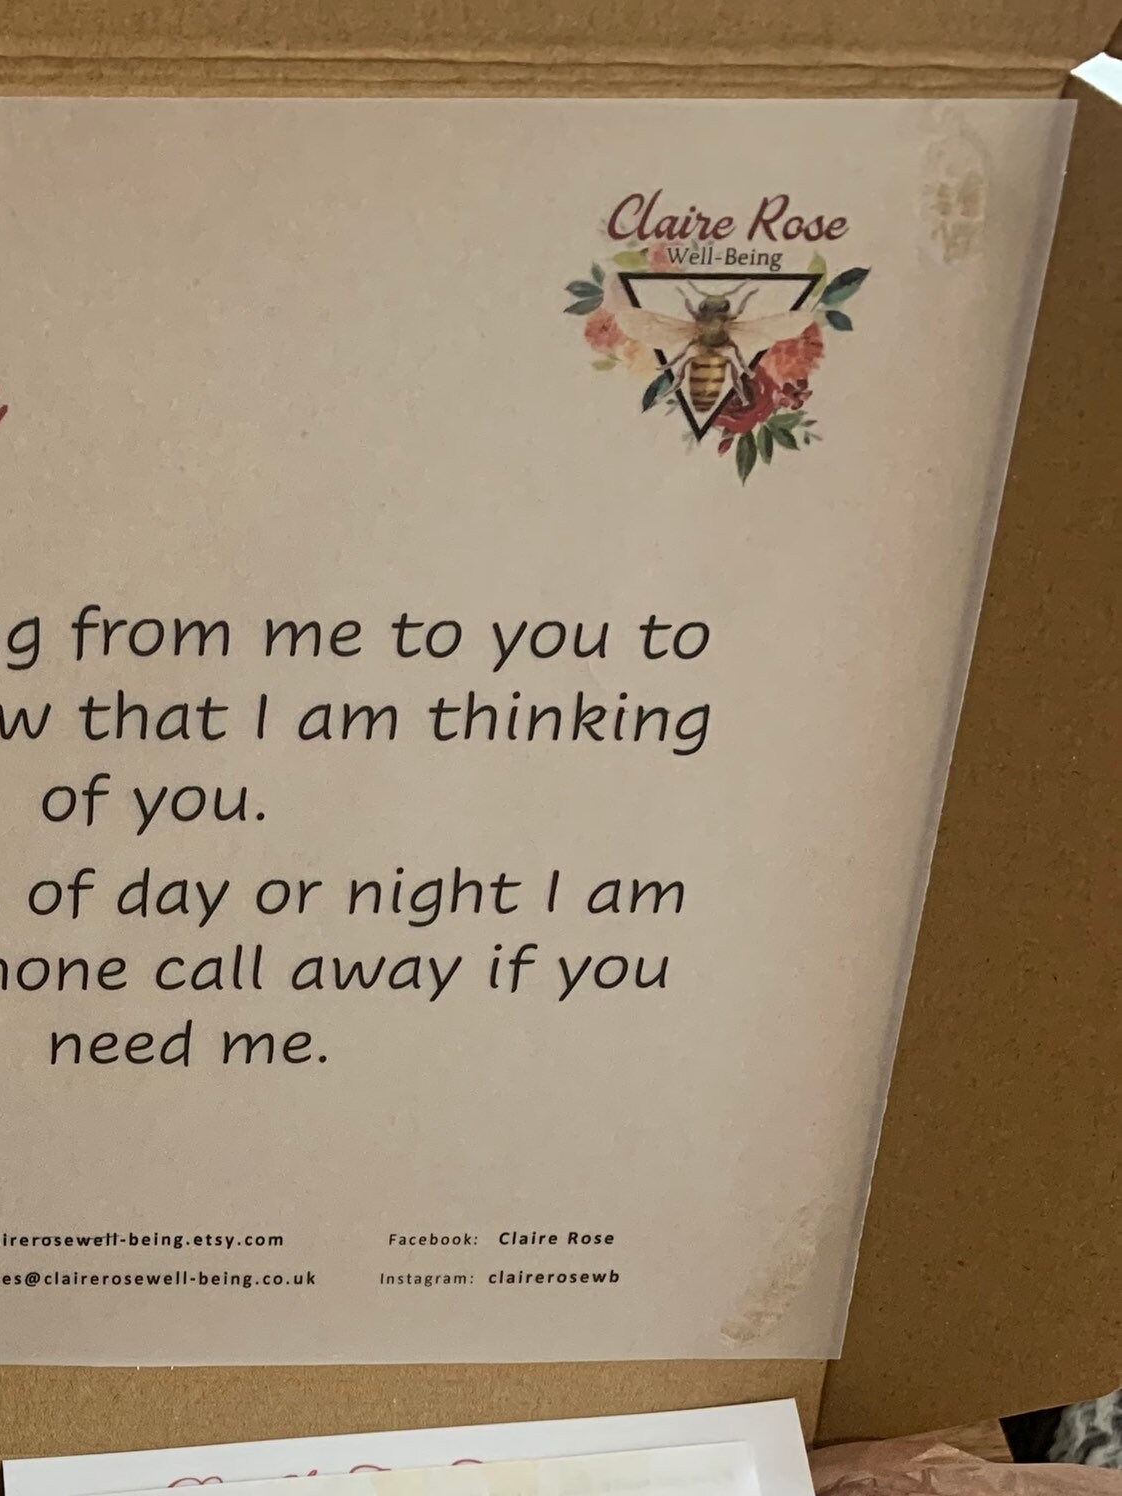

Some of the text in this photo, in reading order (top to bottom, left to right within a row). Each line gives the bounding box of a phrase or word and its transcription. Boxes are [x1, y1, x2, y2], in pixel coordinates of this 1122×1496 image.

[608, 188, 850, 243] Claire Rose
[668, 247, 783, 272] Well-Being
[71, 604, 230, 662] from
[265, 618, 362, 658] me
[391, 612, 462, 659] to
[492, 620, 609, 673] you
[639, 614, 710, 660] to
[78, 689, 229, 741] that
[257, 693, 268, 740] I
[298, 703, 398, 741] am
[428, 690, 710, 756] thinking
[42, 772, 265, 836] of you.
[28, 867, 96, 920] of
[117, 866, 230, 929] day
[256, 879, 323, 915] or
[348, 866, 522, 928] night
[547, 869, 560, 913] I
[587, 878, 685, 914] am
[155, 944, 263, 991] call
[291, 955, 463, 1003] away
[489, 943, 538, 994] if
[558, 955, 669, 1002] you
[50, 1019, 327, 1068] need me.
[388, 1231, 615, 1246] Facebook: Claire Rose
[380, 1269, 620, 1288] Instagram: clairerosewb
